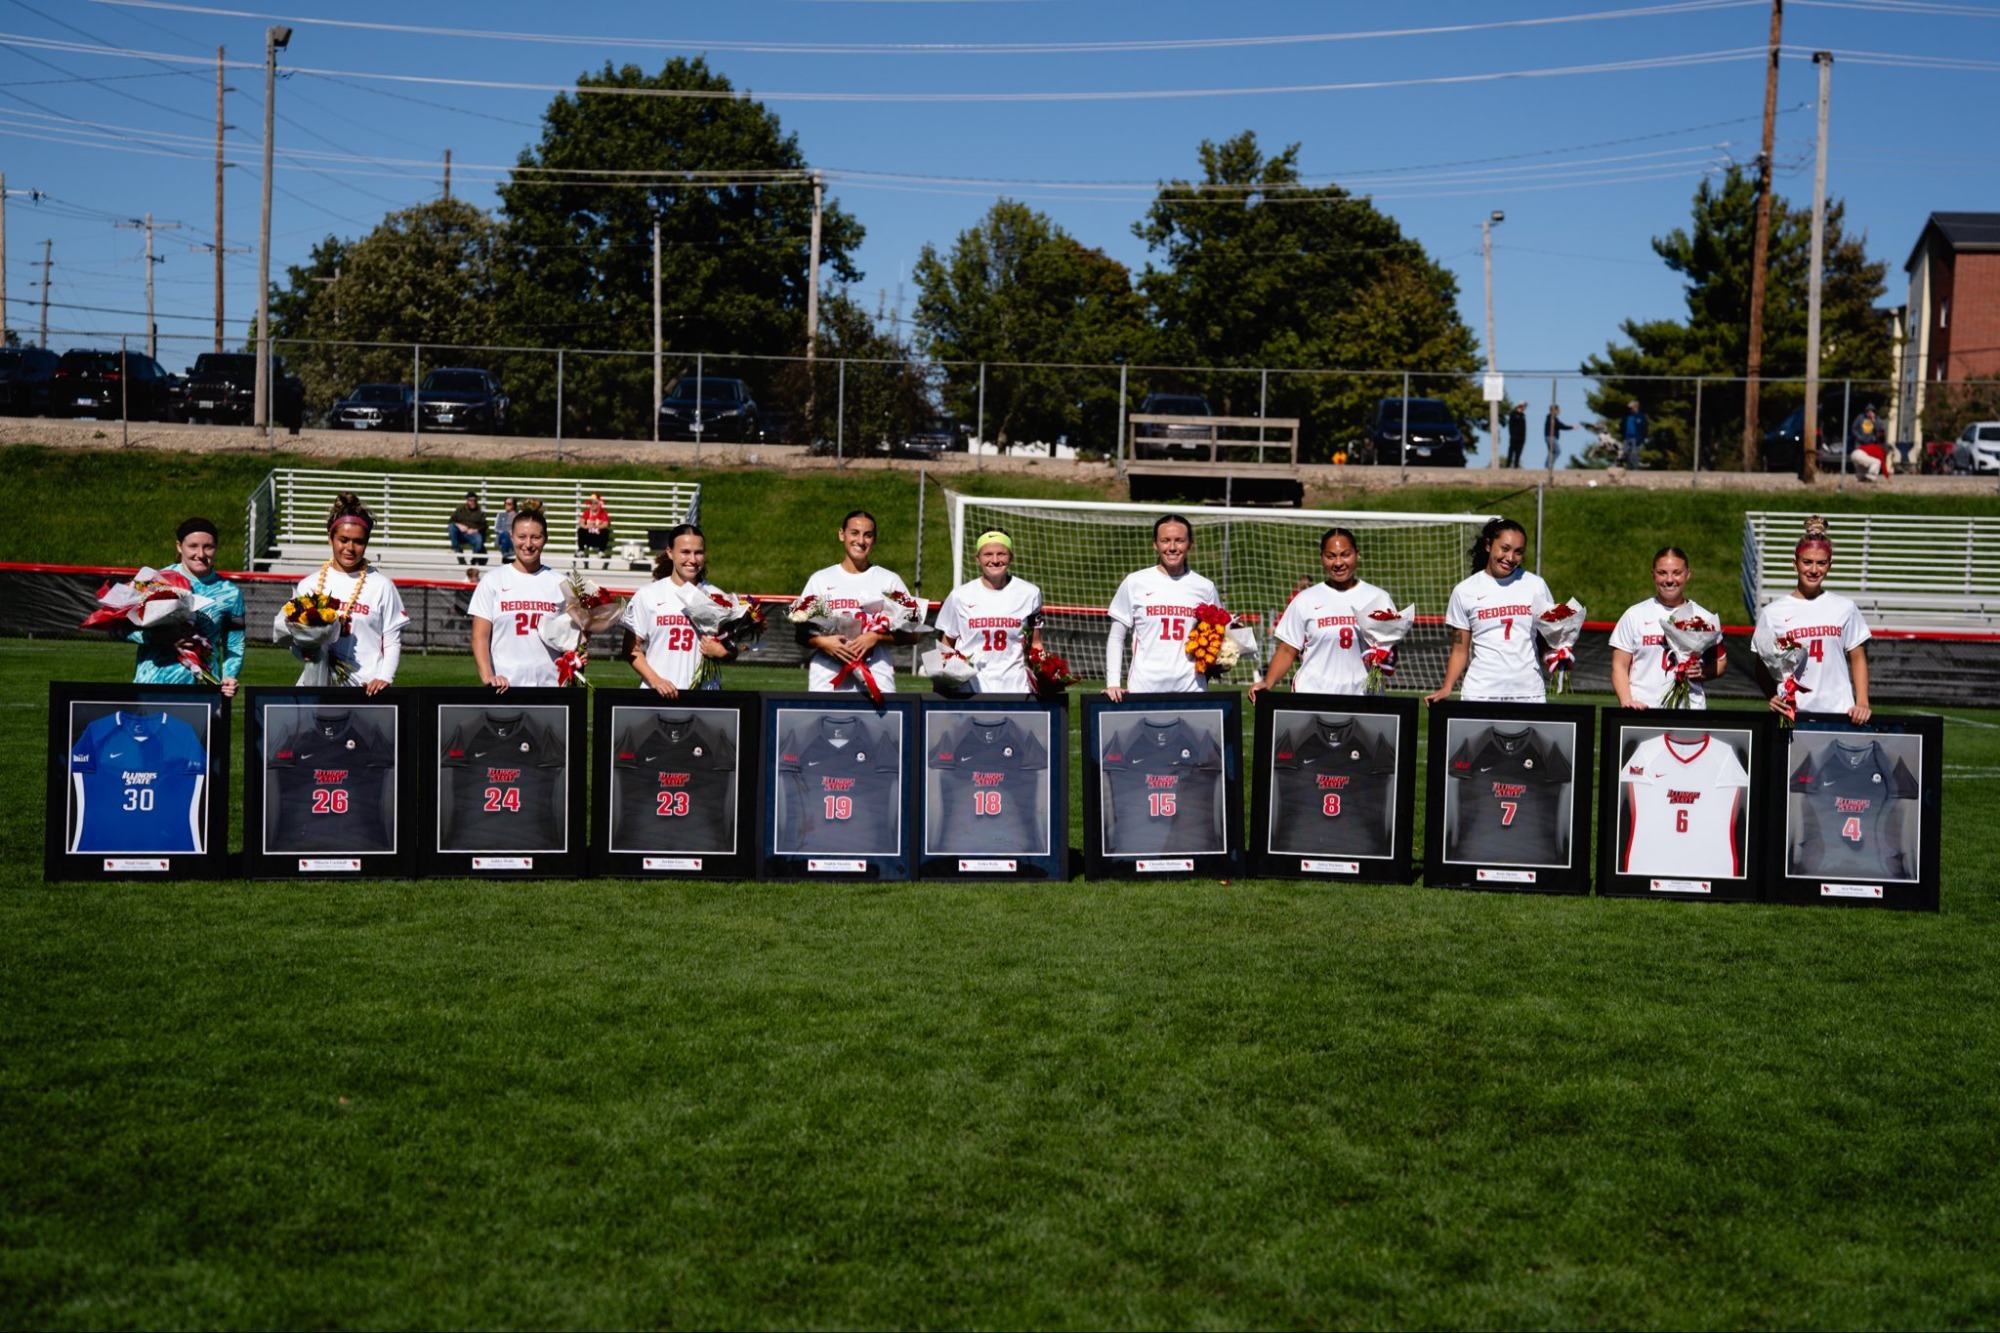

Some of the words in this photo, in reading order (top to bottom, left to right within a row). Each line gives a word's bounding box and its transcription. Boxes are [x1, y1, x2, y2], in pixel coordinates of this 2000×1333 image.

[500, 600, 557, 613] REDBIRDS
[968, 616, 1022, 629] REDBIRDS
[1159, 617, 1186, 641] 15
[1500, 617, 1514, 641] 7
[668, 627, 695, 652] 23
[982, 629, 1008, 652] 18
[1339, 626, 1354, 650] 8
[1808, 639, 1824, 663] 4
[122, 771, 157, 780] ILLINOIS
[124, 777, 152, 785] STATE
[122, 788, 154, 811] 30
[312, 789, 349, 813] 26
[484, 787, 521, 812] 24
[656, 791, 690, 816] 23
[824, 795, 852, 820] 19
[974, 791, 1001, 816] 18
[1148, 793, 1176, 817] 15
[1323, 793, 1340, 816] 8
[1500, 801, 1518, 825] 7
[1676, 809, 1688, 833] 6
[1842, 817, 1861, 841] 4
